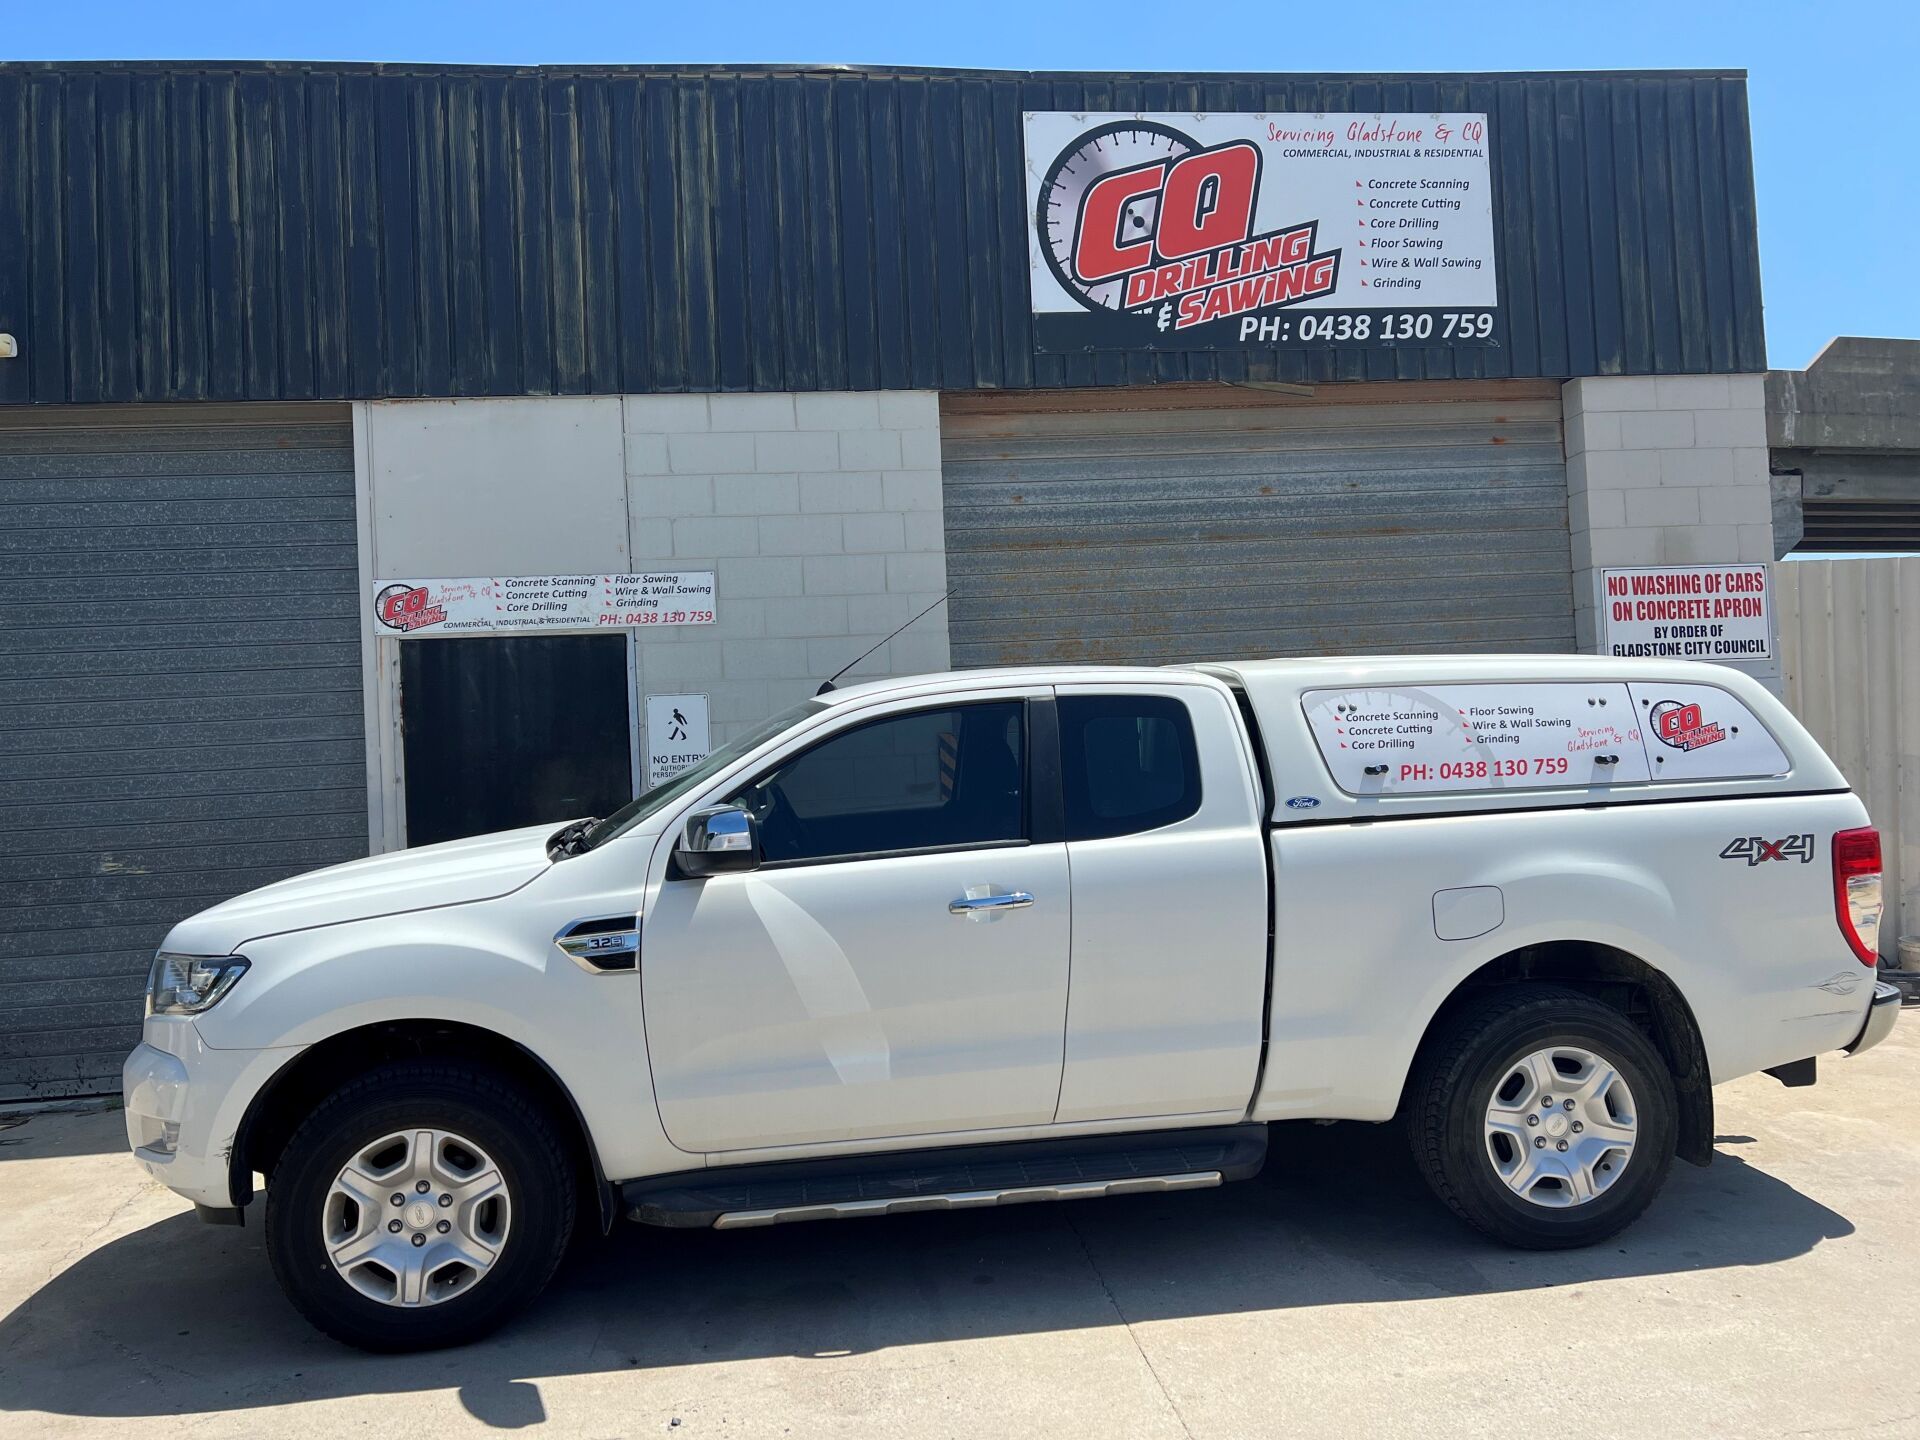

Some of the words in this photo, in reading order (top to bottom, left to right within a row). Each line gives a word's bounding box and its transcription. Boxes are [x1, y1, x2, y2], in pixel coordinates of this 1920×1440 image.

[1267, 121, 1335, 147] Servicing
[1347, 120, 1422, 143] Gladstone
[1434, 123, 1454, 144] &
[1462, 121, 1482, 144] CQ
[1283, 149, 1352, 159] COMMERCIAL,
[1354, 149, 1411, 158] INDUSTRIAL
[1413, 149, 1422, 158] &
[1424, 149, 1484, 158] RESIDENTIAL
[1368, 179, 1417, 189] Concrete
[1419, 179, 1470, 191] Scanning
[1369, 199, 1418, 209] Concrete
[1421, 198, 1461, 210] Cutting
[1075, 144, 1258, 281] CQ
[1370, 218, 1395, 228] Core
[1399, 218, 1439, 230] Drilling
[1371, 238, 1400, 248] Floor
[1402, 238, 1443, 249] Sawing
[1372, 258, 1398, 268] Wire
[1401, 257, 1410, 268] &
[1414, 257, 1439, 268] Wall
[1441, 257, 1481, 269] Sawing
[1373, 277, 1421, 289] Grinding
[1239, 316, 1290, 342] PH:
[1299, 314, 1371, 341] 0438
[1379, 313, 1433, 340] 130
[1441, 313, 1493, 339] 759
[505, 579, 548, 587] Concrete
[551, 577, 596, 586] Scanning
[615, 575, 639, 584] Floor
[642, 574, 678, 584] Sawing
[1608, 576, 1628, 596] NO
[1631, 574, 1701, 595] WASHING
[1705, 573, 1721, 593] OF
[1725, 572, 1764, 593] CARS
[506, 591, 549, 599] Concrete
[552, 589, 587, 598] Cutting
[615, 587, 638, 596] Wire
[641, 586, 649, 595] &
[652, 586, 674, 595] Wall
[676, 585, 711, 594] Sawing
[383, 587, 428, 621] CQ
[507, 603, 529, 611] Core
[532, 602, 567, 611] Drilling
[616, 598, 658, 608] Grinding
[1612, 601, 1633, 621] ON
[1636, 599, 1711, 620] CONCRETE
[1714, 597, 1762, 618] APRON
[547, 616, 590, 624] RESIDENTIAL
[600, 614, 622, 625] PH:
[626, 613, 658, 624] 0438
[662, 612, 685, 623] 130
[689, 611, 713, 622] 759
[1654, 626, 1668, 639] BY
[1671, 625, 1707, 638] ORDER
[1711, 624, 1723, 637] OF
[1613, 642, 1682, 657] GLADSTONE
[1684, 641, 1711, 655] CITY
[1714, 639, 1766, 654] COUNCIL
[1346, 712, 1390, 722] Concrete
[1393, 711, 1439, 721] Scanning
[1470, 707, 1495, 716] Floor
[1497, 706, 1534, 716] Sawing
[1472, 721, 1498, 730] Wire
[1499, 720, 1507, 729] &
[1510, 719, 1533, 729] Wall
[1535, 718, 1571, 728] Sawing
[1660, 704, 1701, 739] CQ
[1349, 726, 1394, 736] Concrete
[1396, 724, 1433, 735] Cutting
[1577, 726, 1615, 738] Servicing
[1351, 740, 1375, 750] Core
[1378, 738, 1415, 749] Drilling
[1476, 734, 1520, 744] Grinding
[1567, 737, 1608, 752] Gladstone
[1628, 728, 1640, 741] CQ
[653, 755, 669, 764] NO
[1400, 763, 1434, 781] PH:
[1439, 761, 1487, 779] 0438
[1494, 759, 1528, 777] 130
[1533, 757, 1568, 775] 759
